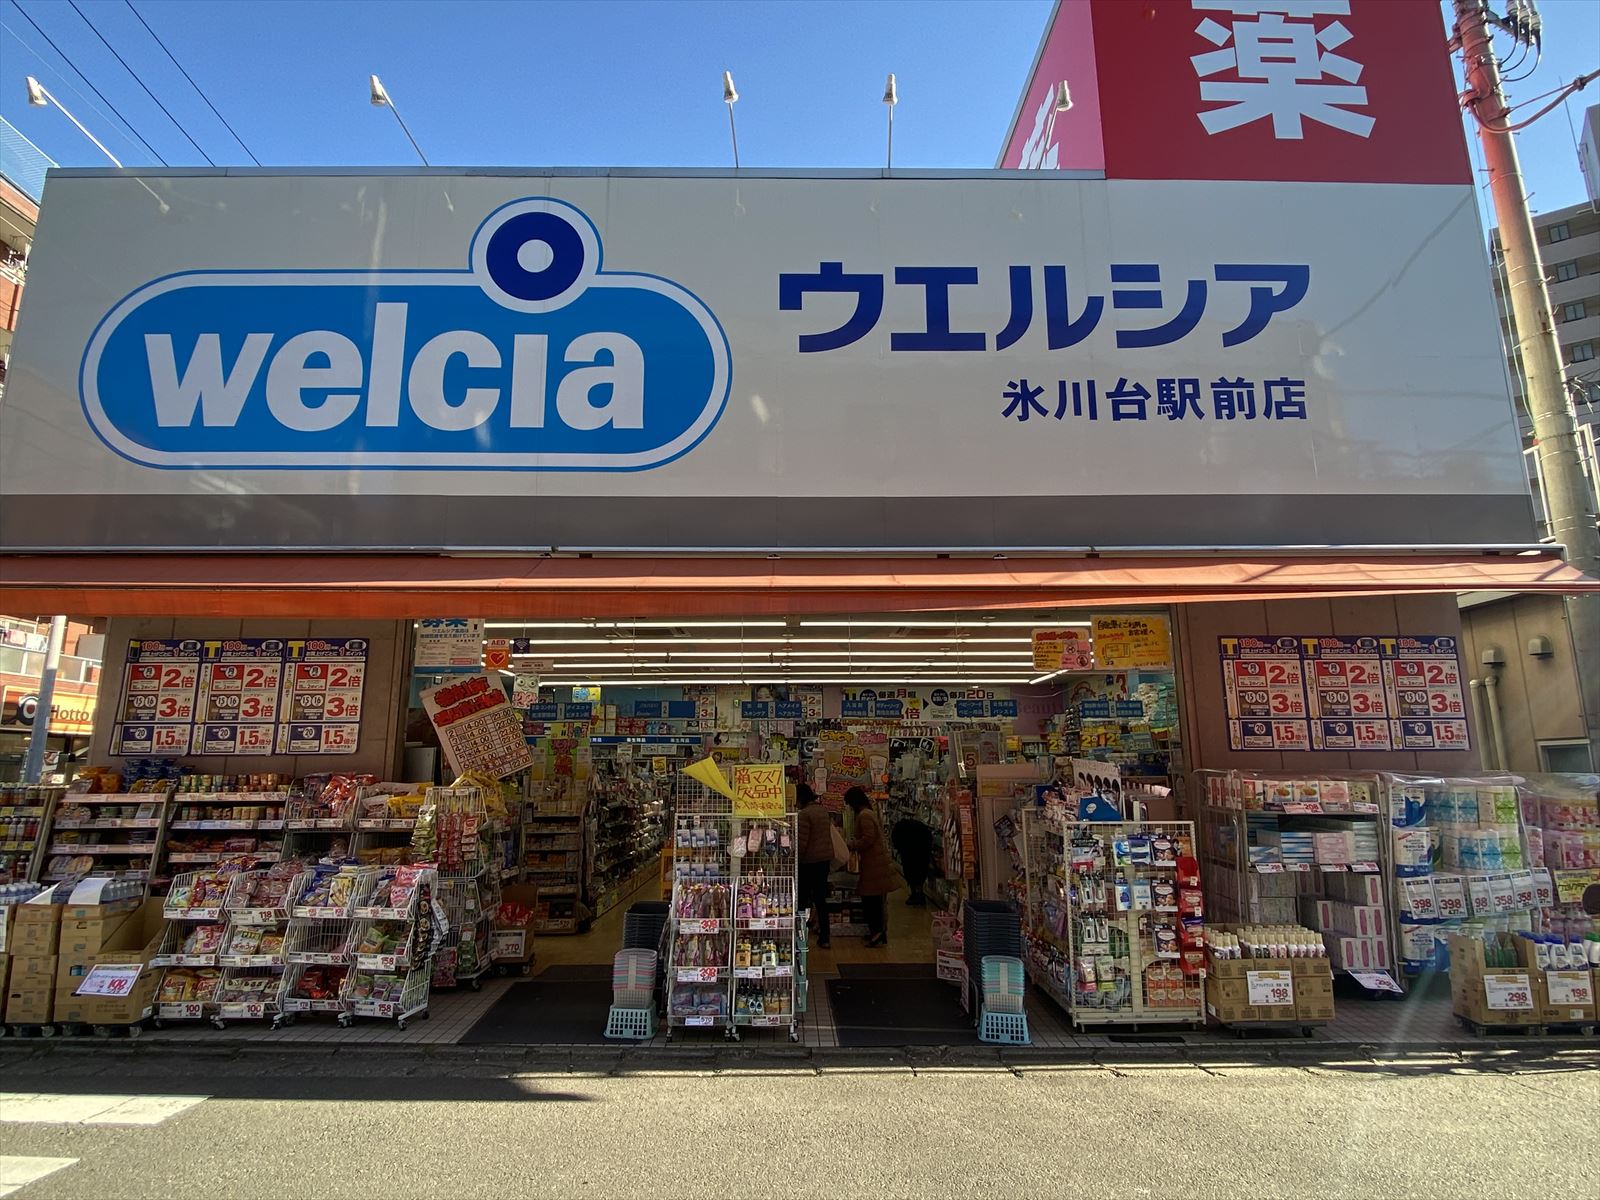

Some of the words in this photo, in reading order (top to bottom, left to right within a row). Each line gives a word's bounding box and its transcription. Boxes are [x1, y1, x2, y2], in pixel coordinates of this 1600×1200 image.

[1190, 0, 1376, 139] 薬
[779, 261, 1310, 353] ウエルシア
[143, 211, 646, 432] welcia
[1001, 377, 1308, 422] 氷川台駅前店
[204, 641, 222, 658] T
[288, 641, 305, 657] T
[1221, 638, 1238, 655] T
[1301, 638, 1318, 655] T
[1380, 638, 1397, 655] T
[162, 669, 194, 688] 2倍
[244, 669, 277, 688] 2倍
[329, 668, 361, 687] 2倍
[1269, 665, 1300, 684] 2倍
[1349, 665, 1380, 684] 2倍
[1427, 665, 1457, 684] 2倍
[950, 690, 994, 699] 毎月20日
[1272, 694, 1303, 713] 3倍
[1353, 694, 1384, 713] 3倍
[1431, 694, 1461, 713] 3倍
[159, 698, 191, 717] 3倍
[242, 698, 273, 717] 3倍
[326, 697, 358, 717] 3倍
[737, 785, 782, 799] 欠品中
[1413, 898, 1432, 908] 398
[1441, 899, 1461, 909] 398
[259, 911, 272, 919] 118
[1271, 988, 1288, 998] 198
[1508, 992, 1527, 1001] 298
[1571, 988, 1588, 997] 198
[185, 1004, 200, 1012] 100
[246, 1004, 261, 1013] 100
